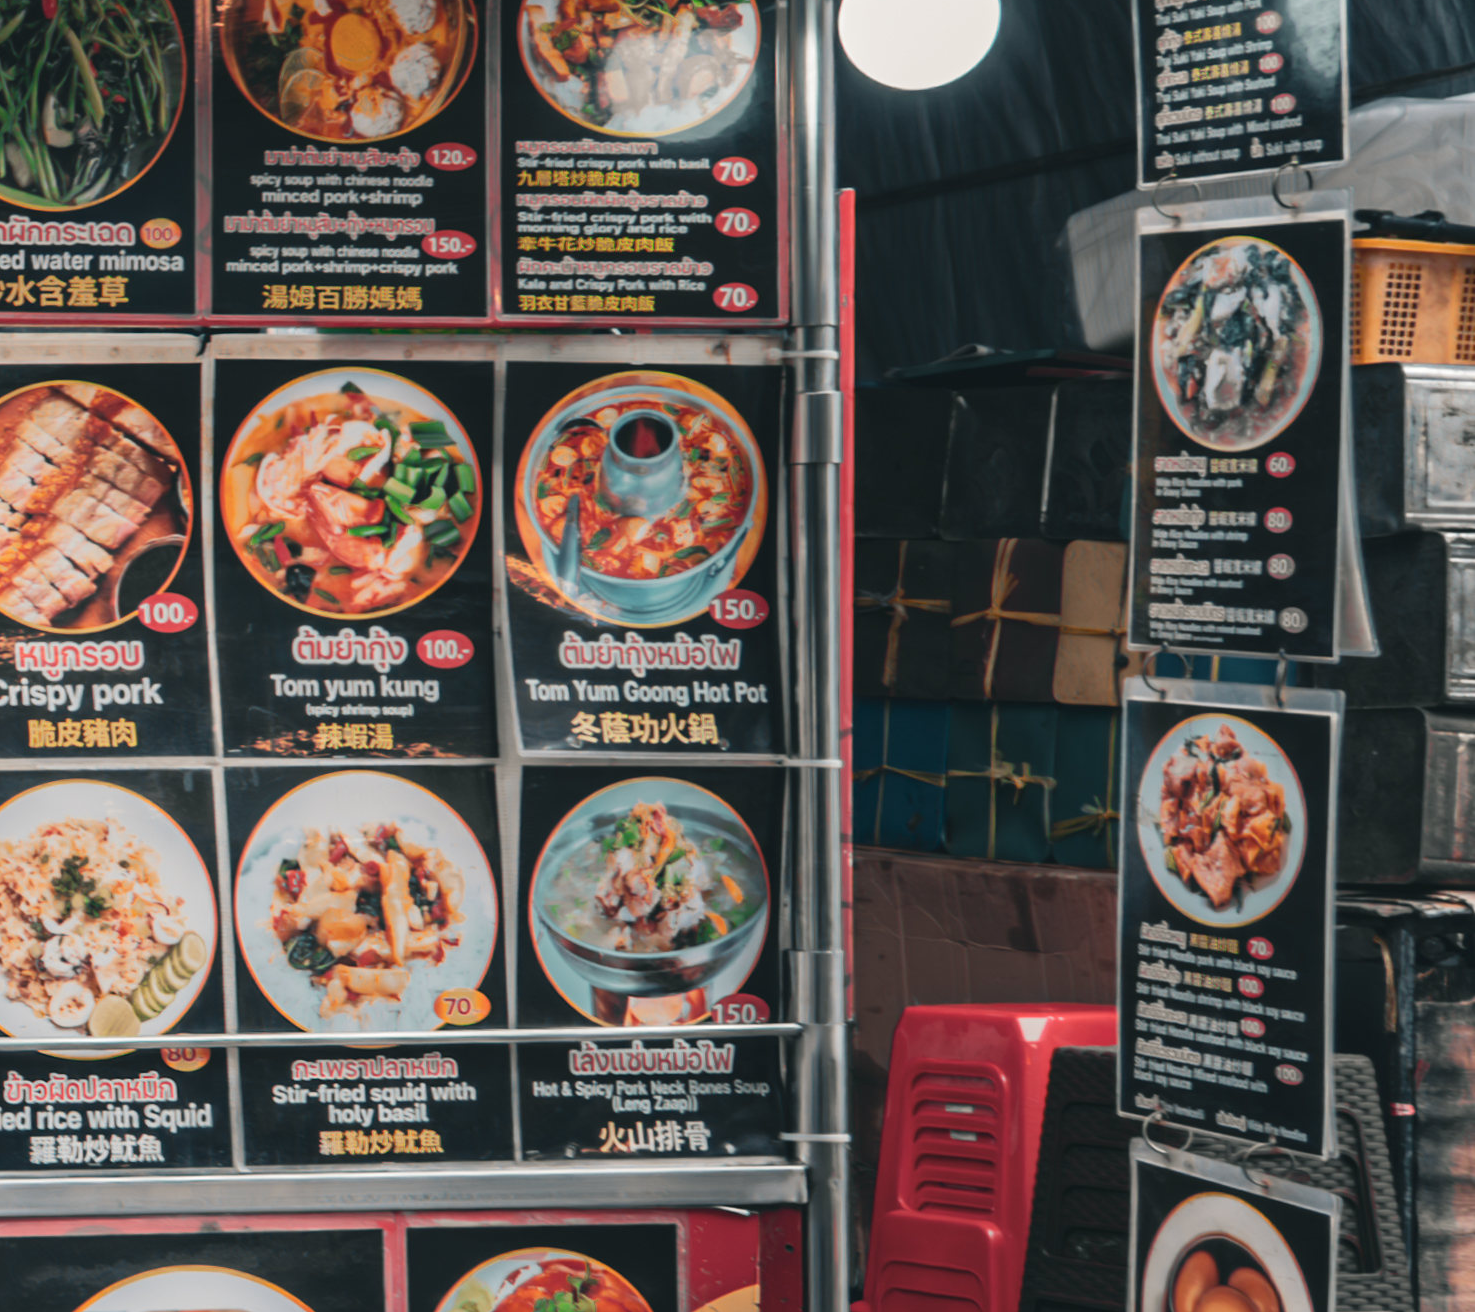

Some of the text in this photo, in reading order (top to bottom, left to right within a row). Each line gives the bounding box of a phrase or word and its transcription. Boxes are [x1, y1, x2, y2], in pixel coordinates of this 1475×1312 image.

[262, 189, 423, 207] minced pork+shrimp
[92, 677, 163, 711] pork
[270, 674, 439, 702] Tom yum kung
